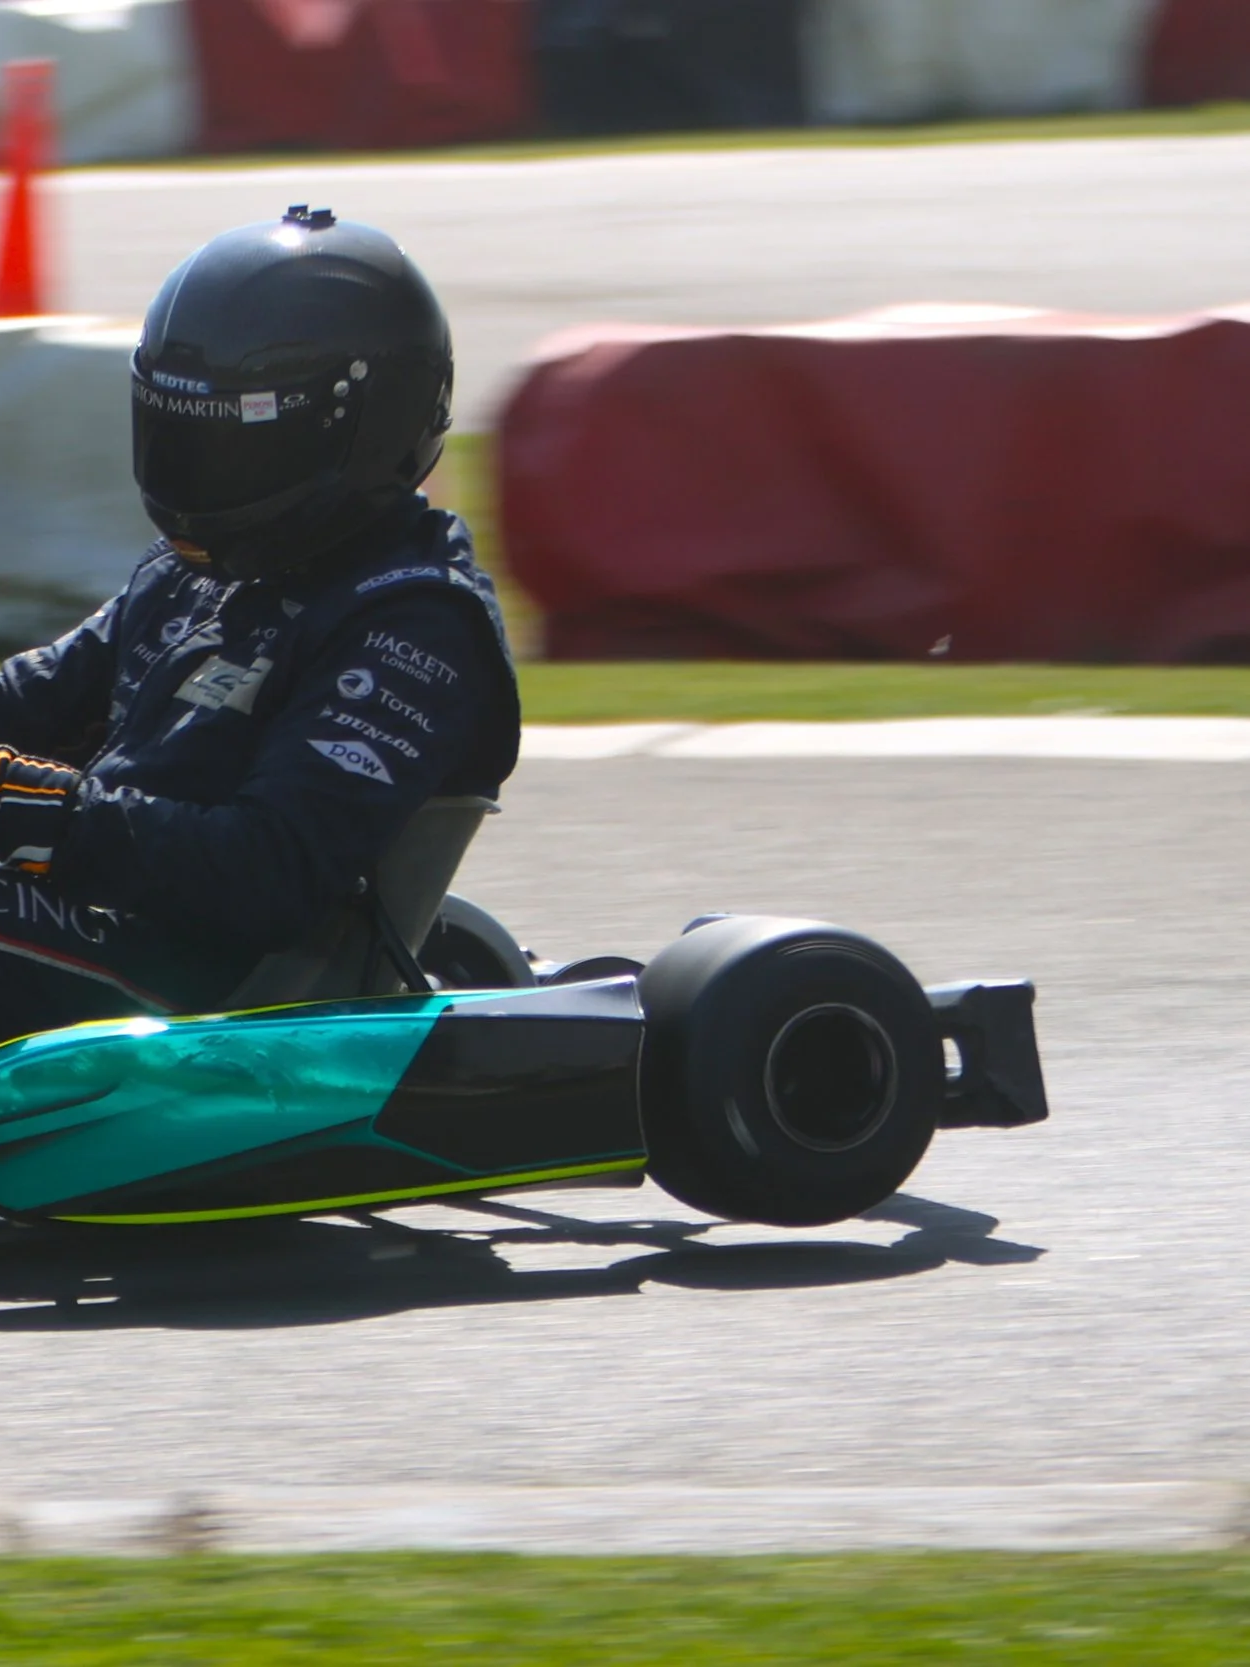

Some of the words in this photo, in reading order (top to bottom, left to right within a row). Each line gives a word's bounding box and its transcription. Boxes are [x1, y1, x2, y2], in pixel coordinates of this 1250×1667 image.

[167, 397, 240, 418] MARTIN
[363, 631, 458, 685] HACKETT
[380, 654, 433, 684] LONDON
[379, 687, 435, 733] TOTAL
[333, 712, 421, 759] DUNLOP
[329, 743, 382, 775] DOW
